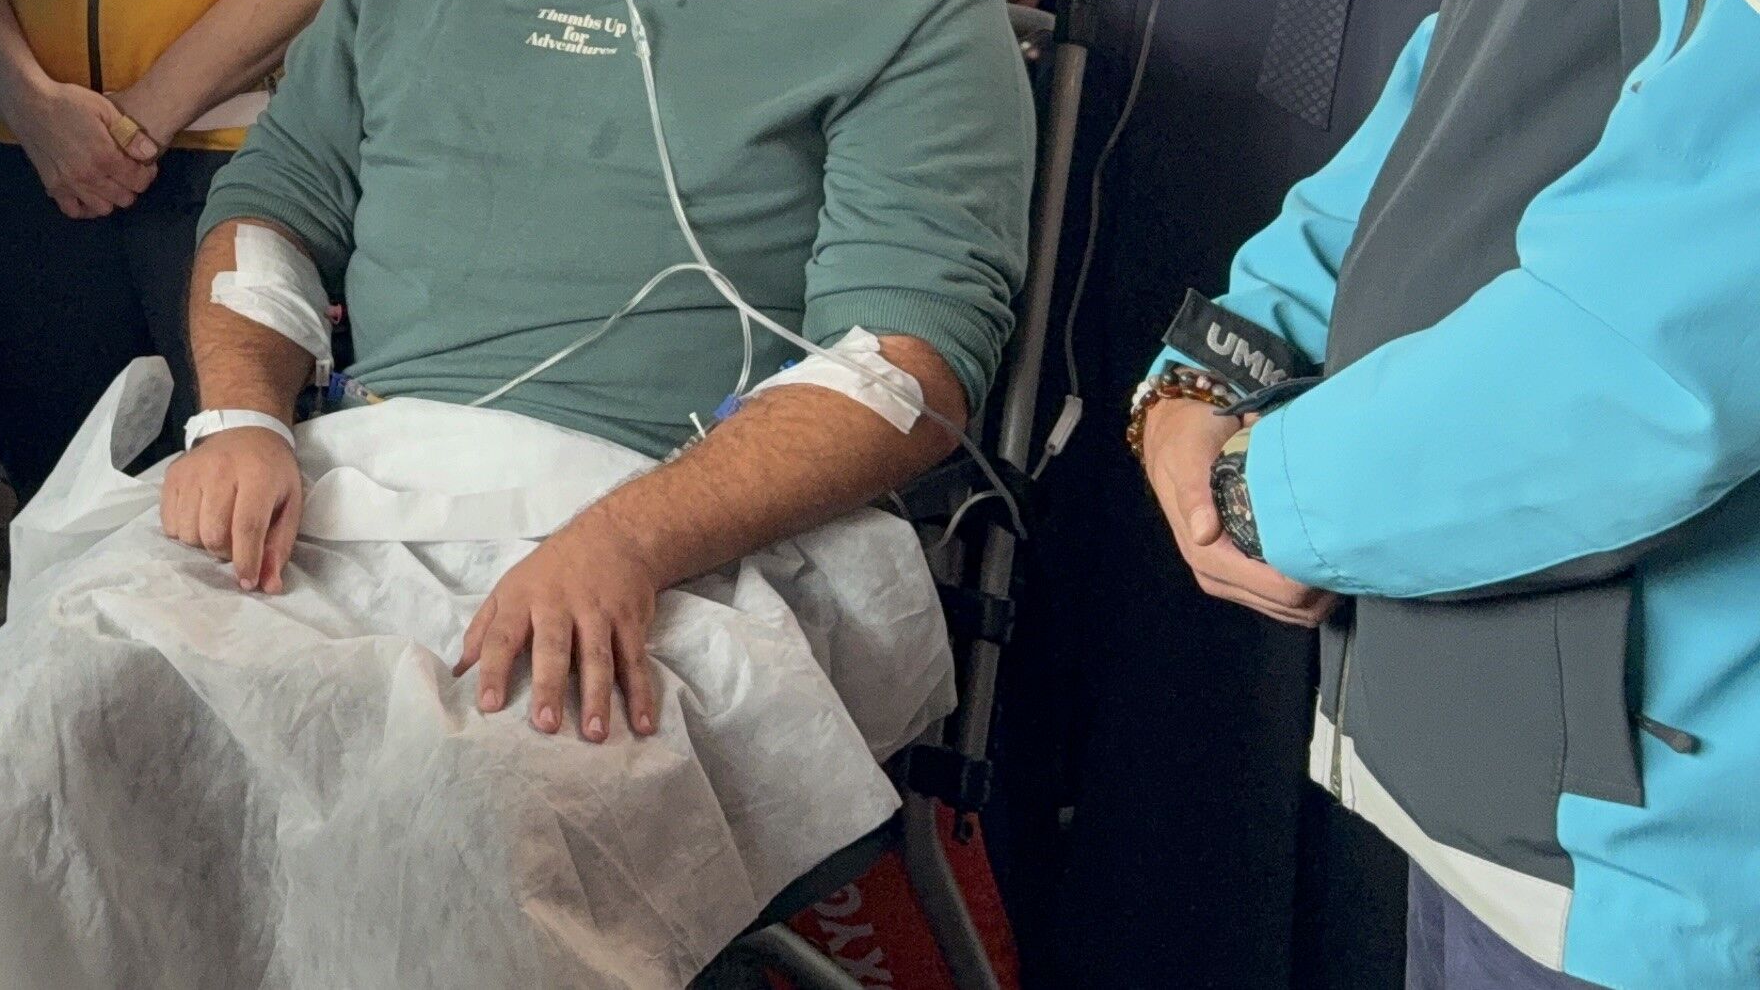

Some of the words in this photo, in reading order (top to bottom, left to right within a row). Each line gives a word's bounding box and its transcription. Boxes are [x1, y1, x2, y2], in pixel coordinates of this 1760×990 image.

[537, 9, 602, 30] Thumbs
[604, 17, 628, 38] Up
[563, 25, 590, 44] for
[1206, 321, 1288, 386] UMK
